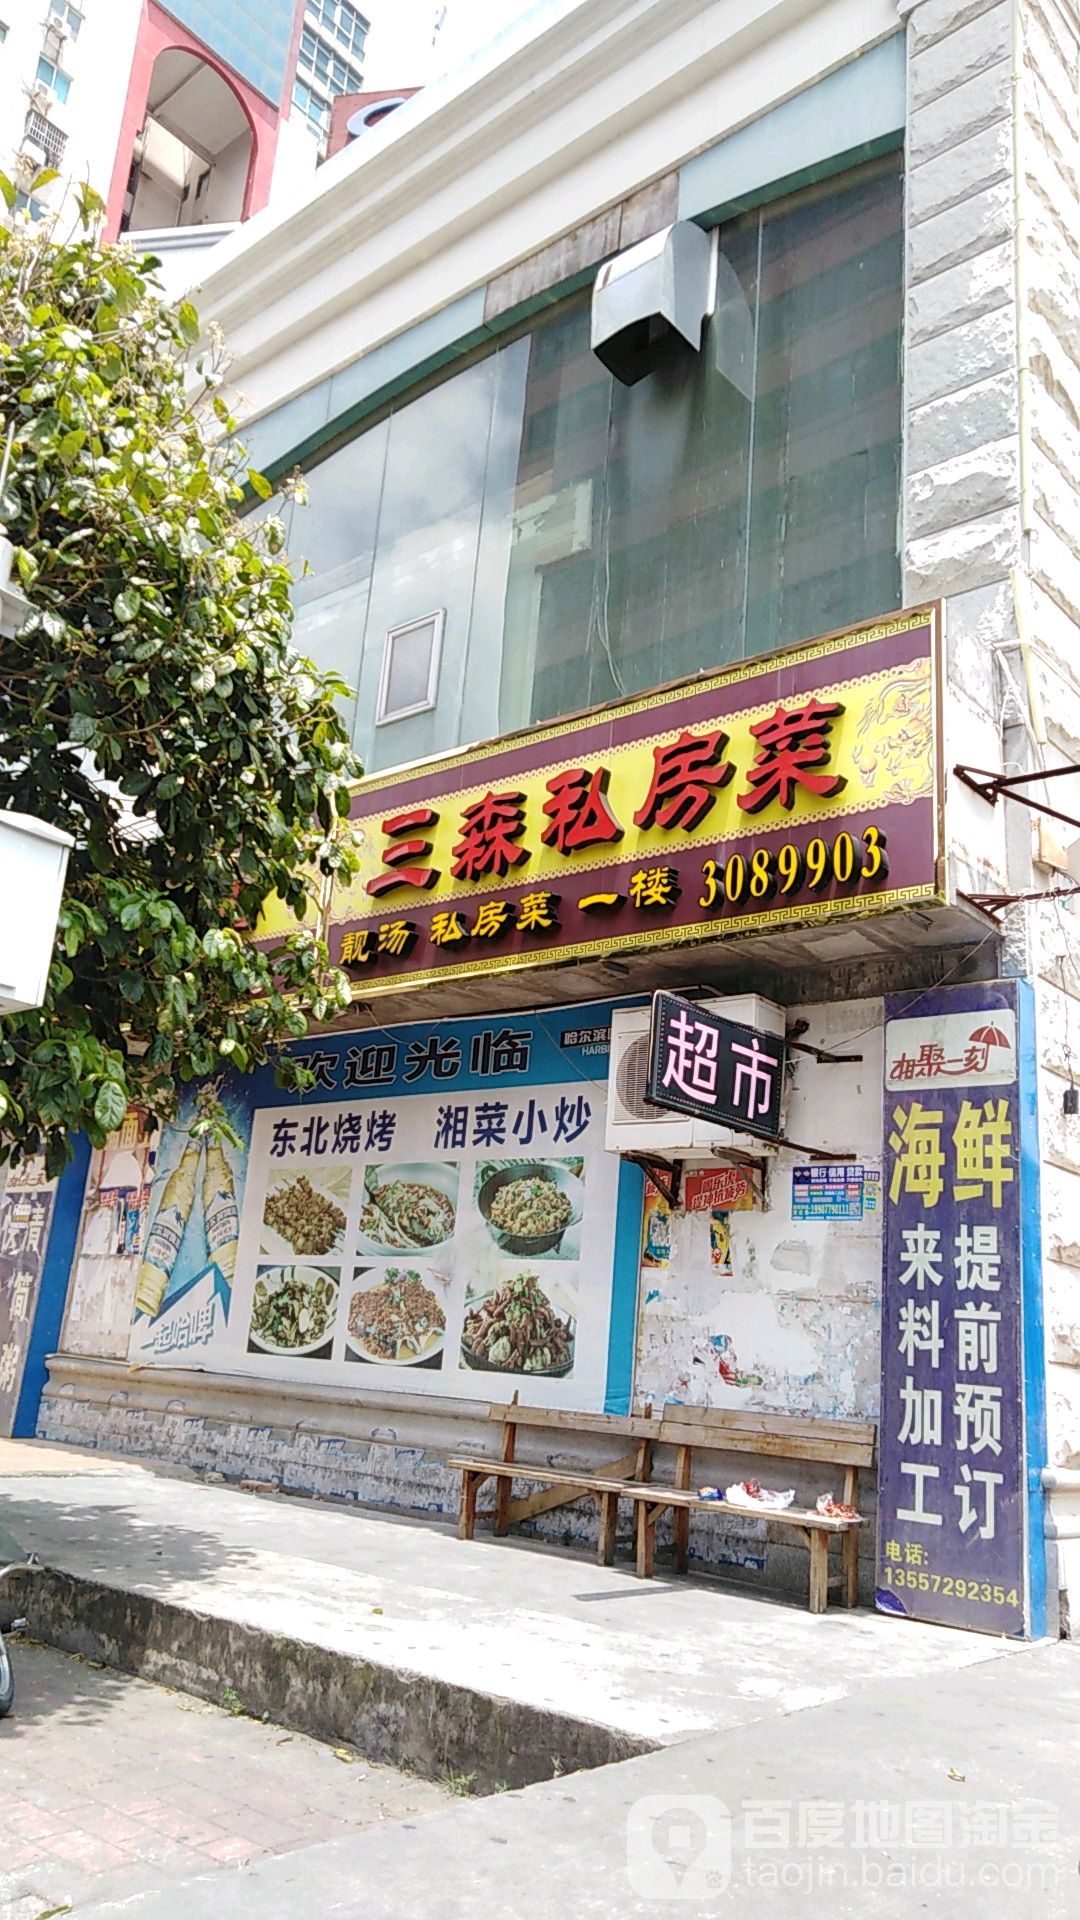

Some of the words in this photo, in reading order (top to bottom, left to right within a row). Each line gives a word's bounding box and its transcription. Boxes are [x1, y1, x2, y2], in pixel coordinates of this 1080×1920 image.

[366, 697, 848, 898] 三森私房菜
[340, 920, 412, 965] 靓汤
[429, 891, 554, 947] 私房菜
[699, 825, 885, 908] 3089903
[288, 1029, 534, 1094] 欢迎光临
[564, 1027, 611, 1045] 哈尔滨
[662, 1010, 778, 1119] 超市
[889, 1043, 990, 1080] 相聚一刻
[269, 1109, 397, 1157] 东北烧烤
[434, 1095, 592, 1150] 湘菜小炒
[888, 1098, 1014, 1208] 海鲜
[897, 1222, 945, 1526] 来料加工
[953, 1224, 1004, 1539] 提前预订
[884, 1538, 930, 1567] 电话:
[884, 1566, 1019, 1608] 13557292354
